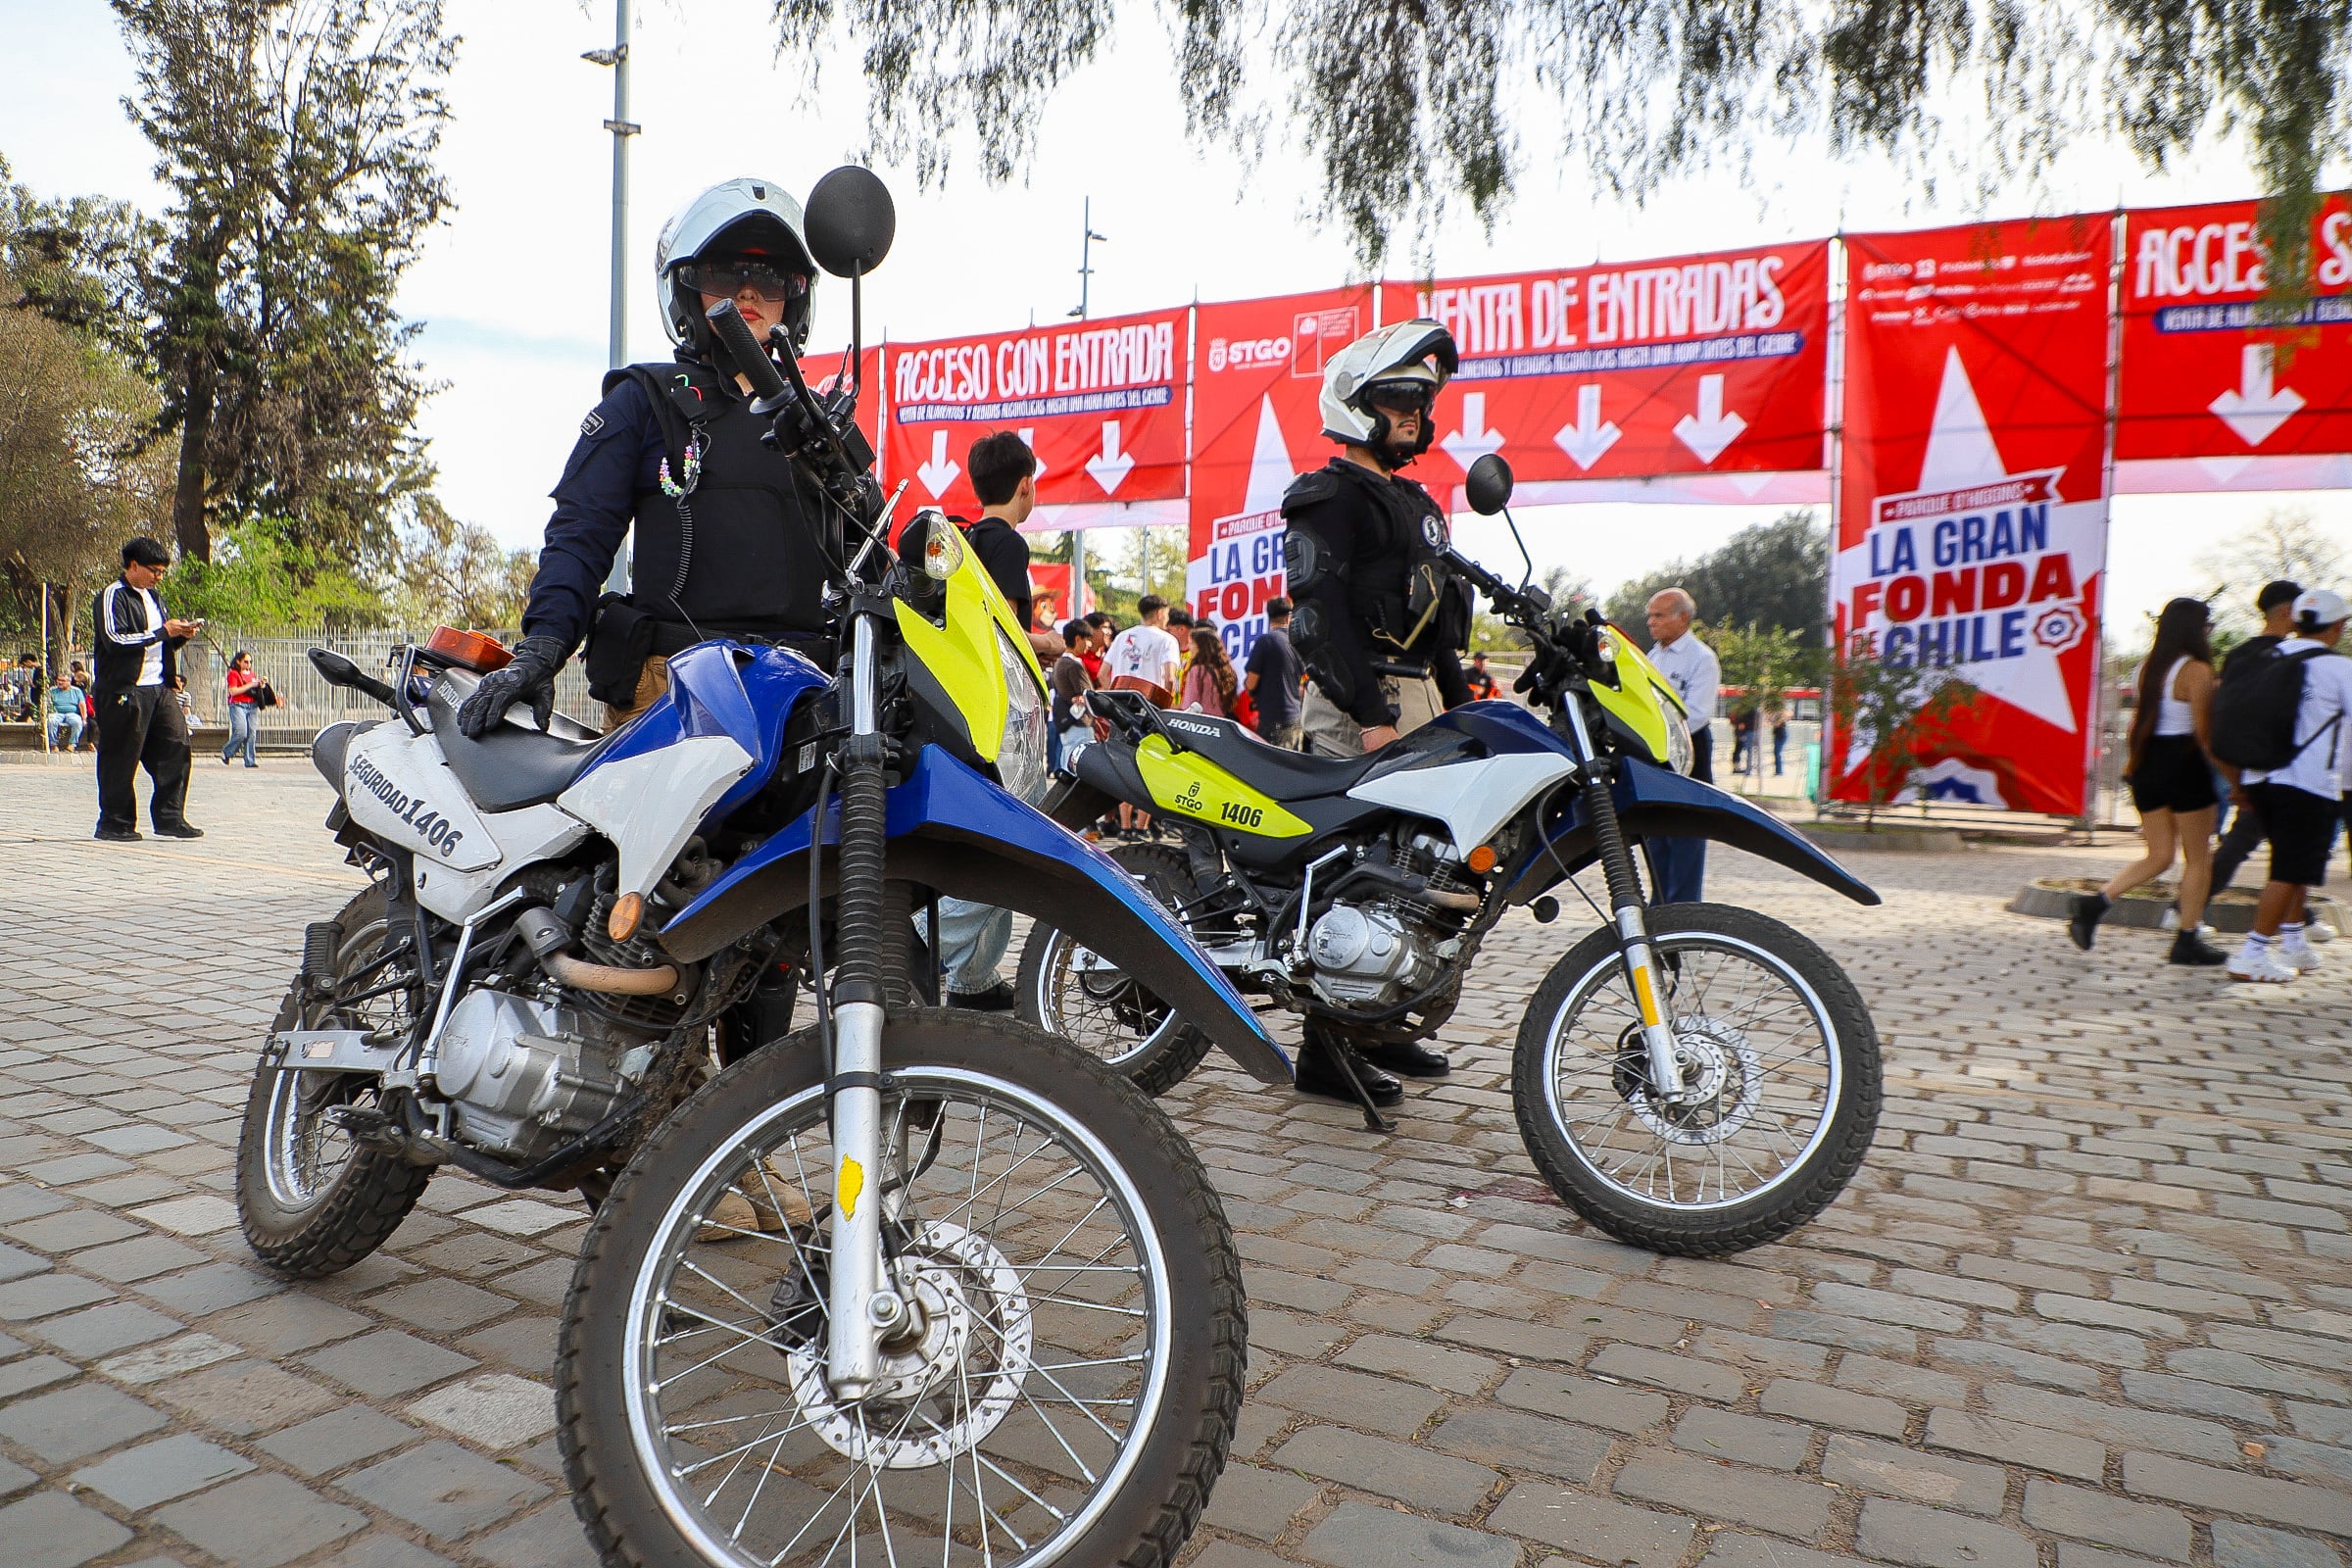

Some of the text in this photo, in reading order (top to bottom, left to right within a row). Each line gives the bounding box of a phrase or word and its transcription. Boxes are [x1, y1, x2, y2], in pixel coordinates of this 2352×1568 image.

[2135, 212, 2352, 298] ACCES S
[1532, 275, 1579, 349] DE
[1587, 255, 1785, 344] ENTRADAS
[894, 320, 1174, 403] ACCESO CON ENTRADA
[1228, 336, 1292, 364] STGO
[1228, 513, 1265, 536] PARQUE
[1871, 503, 2047, 577] LA GRAN
[1211, 531, 1287, 584] LA GR
[1198, 573, 1283, 620] FON
[1852, 552, 2076, 629] FONDA
[1851, 610, 2027, 669] DE CHILE
[436, 680, 465, 714] HONDA
[1166, 717, 1221, 738] HONDA
[348, 754, 464, 858] SEGURIDAD 1406
[1174, 794, 1202, 810] STGO
[1220, 802, 1264, 828] 1406
